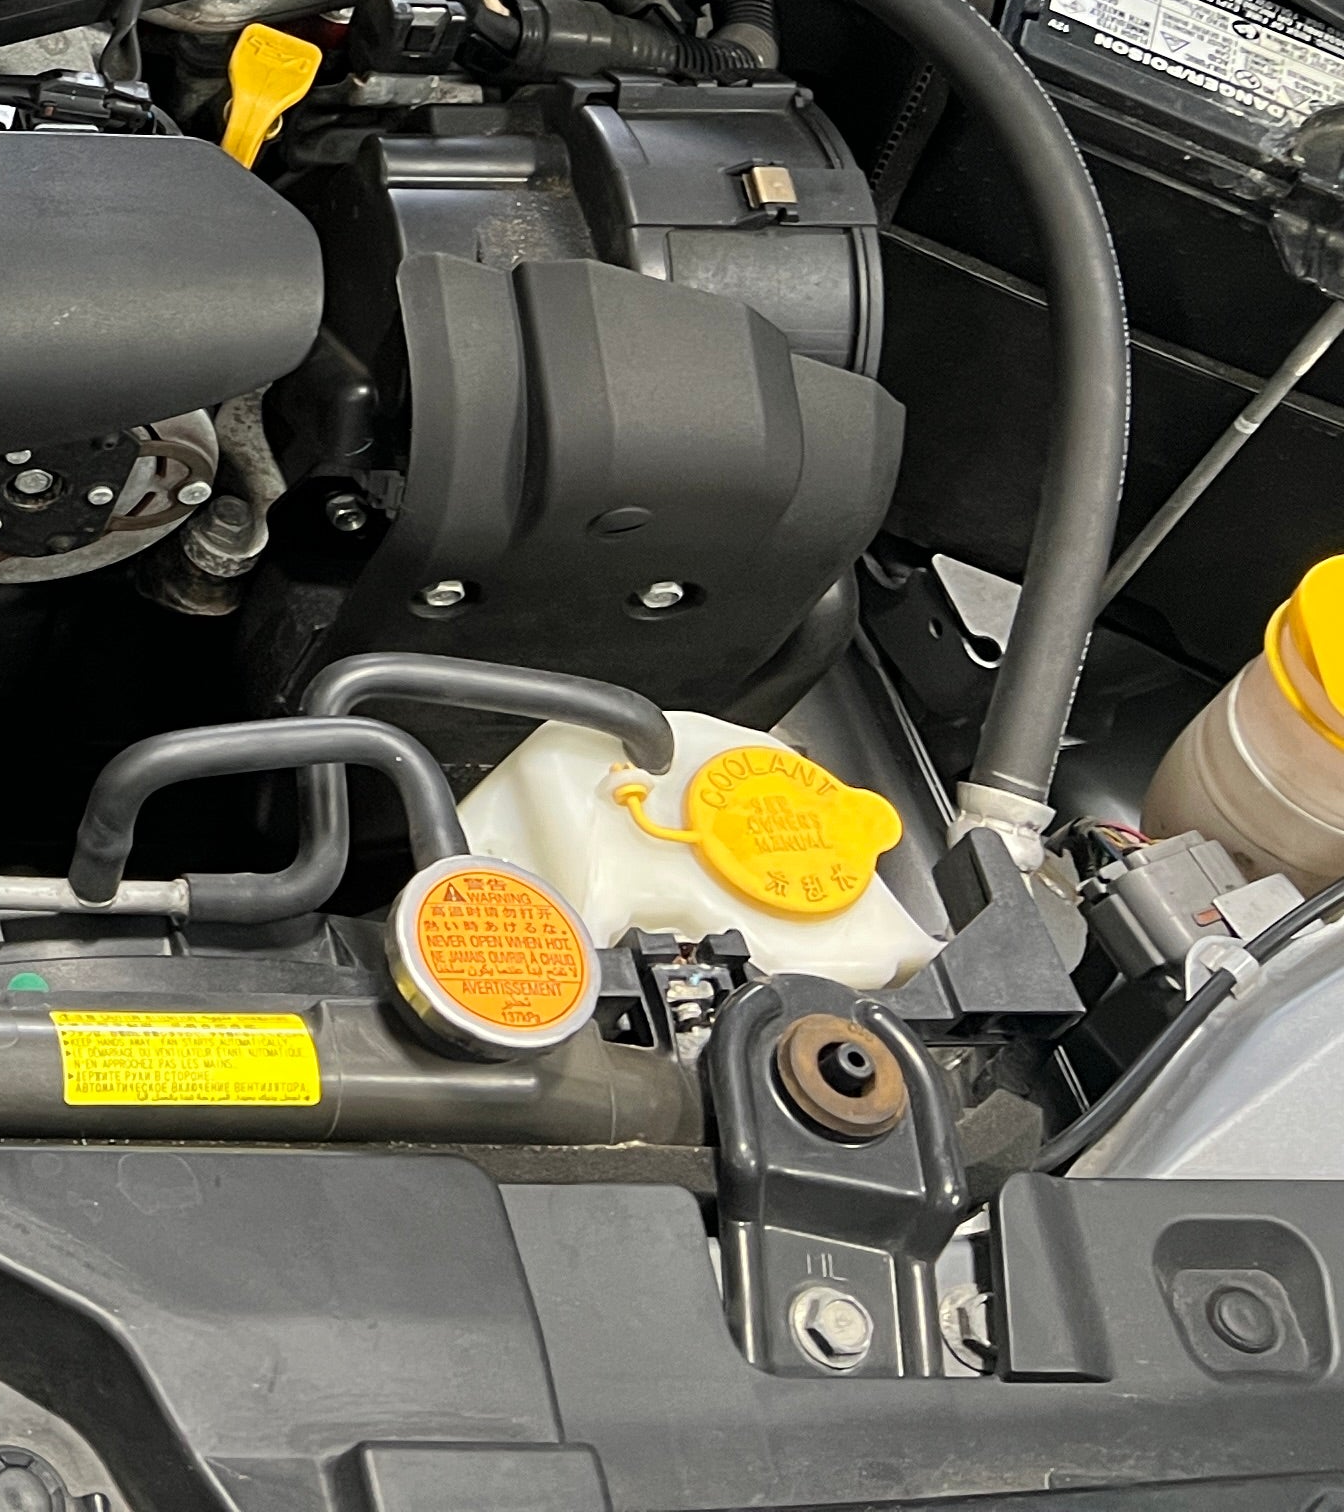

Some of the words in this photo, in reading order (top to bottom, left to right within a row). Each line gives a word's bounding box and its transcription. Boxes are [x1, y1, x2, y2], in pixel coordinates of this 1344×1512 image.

[1092, 32, 1285, 119] DANGER/POISON
[699, 751, 839, 812] COOLANT
[753, 831, 834, 854] MANUAL
[468, 892, 533, 905] WARNING
[426, 934, 467, 948] NEVER
[469, 935, 503, 949] OPEN
[504, 936, 544, 950] WHEN
[448, 950, 487, 964] JAMAIS
[488, 950, 527, 965] OUVRIR
[462, 981, 562, 997] AVERTISSEMENT
[102, 1058, 153, 1069] APPROCHEZ
[158, 1059, 177, 1069] PAS
[181, 1059, 199, 1069] LES
[154, 1071, 161, 1081] В
[75, 1083, 168, 1093] АВТОМАТИЧЕСКОЕ
[171, 1082, 230, 1093] ВКЛЮЧЕНИЕ
